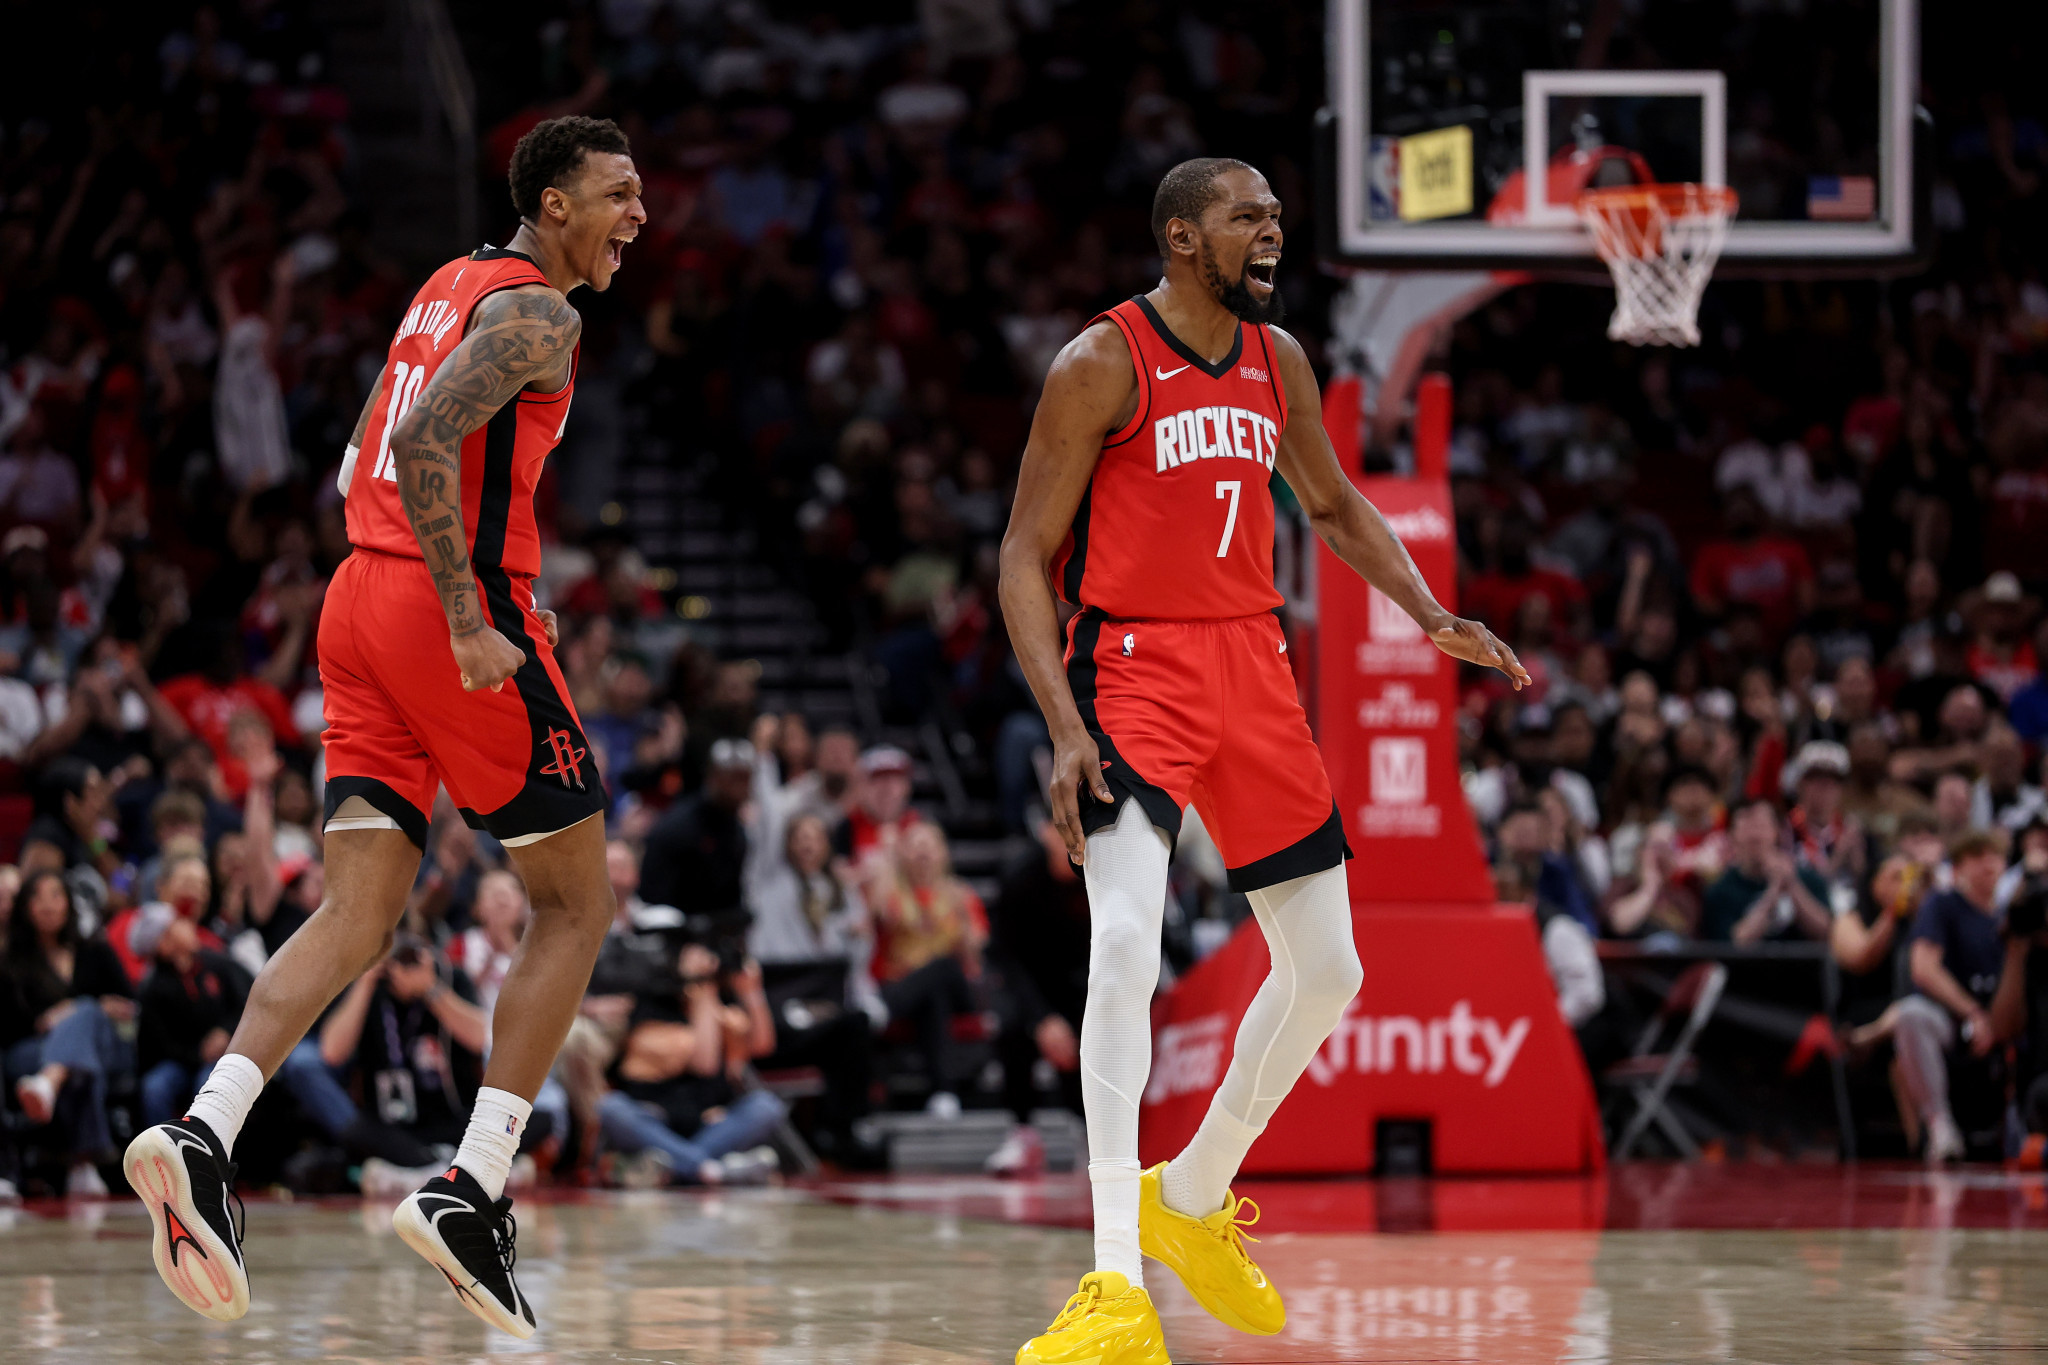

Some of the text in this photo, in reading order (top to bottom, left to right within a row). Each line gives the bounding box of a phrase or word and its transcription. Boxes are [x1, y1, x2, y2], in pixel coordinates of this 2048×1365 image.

[395, 299, 450, 347] SMITH
[408, 447, 456, 472] AUBURN
[1154, 406, 1278, 474] ROCKETS
[1215, 480, 1241, 558] 7
[454, 592, 465, 616] 5
